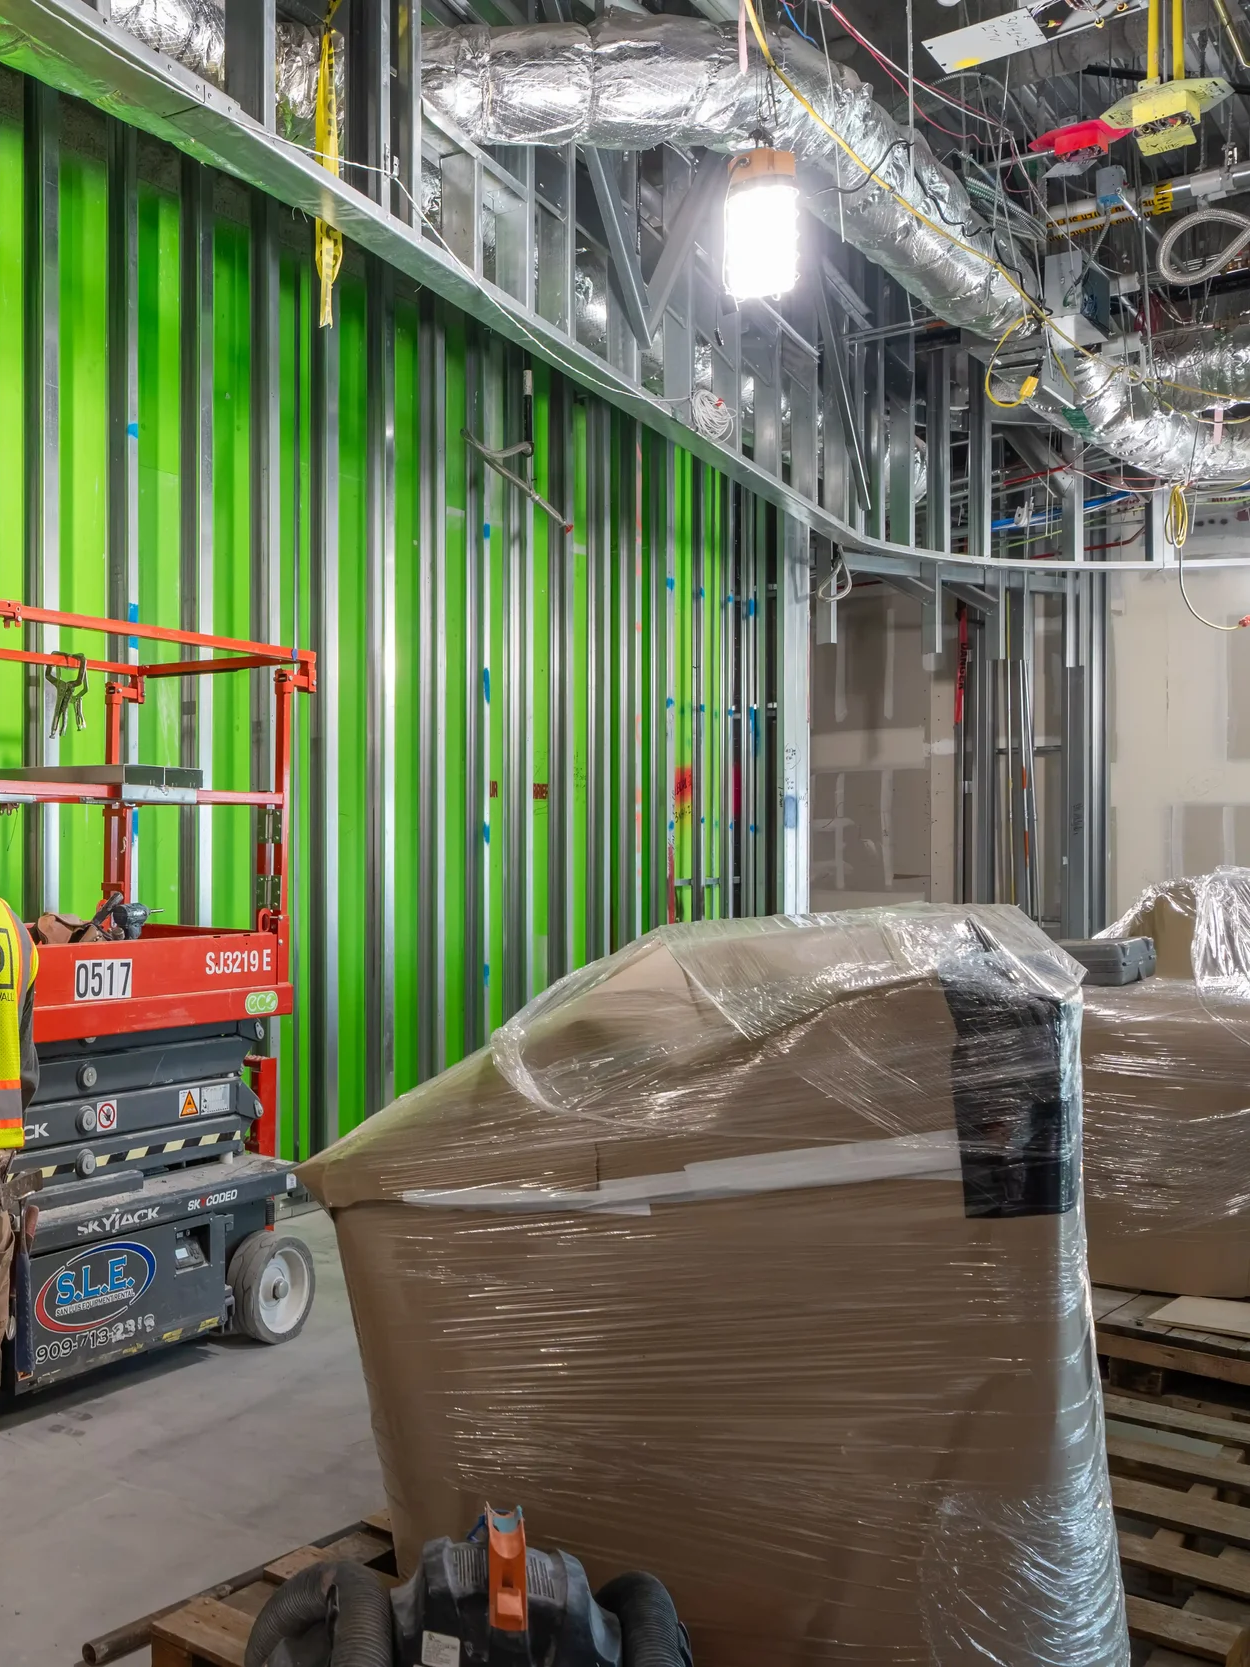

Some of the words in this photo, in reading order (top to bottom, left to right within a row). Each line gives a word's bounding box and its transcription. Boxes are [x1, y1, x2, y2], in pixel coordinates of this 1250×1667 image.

[76, 961, 132, 999] 0517
[205, 950, 260, 975] SJ3219
[263, 948, 272, 971] E
[56, 1254, 136, 1306] S.L.E.
